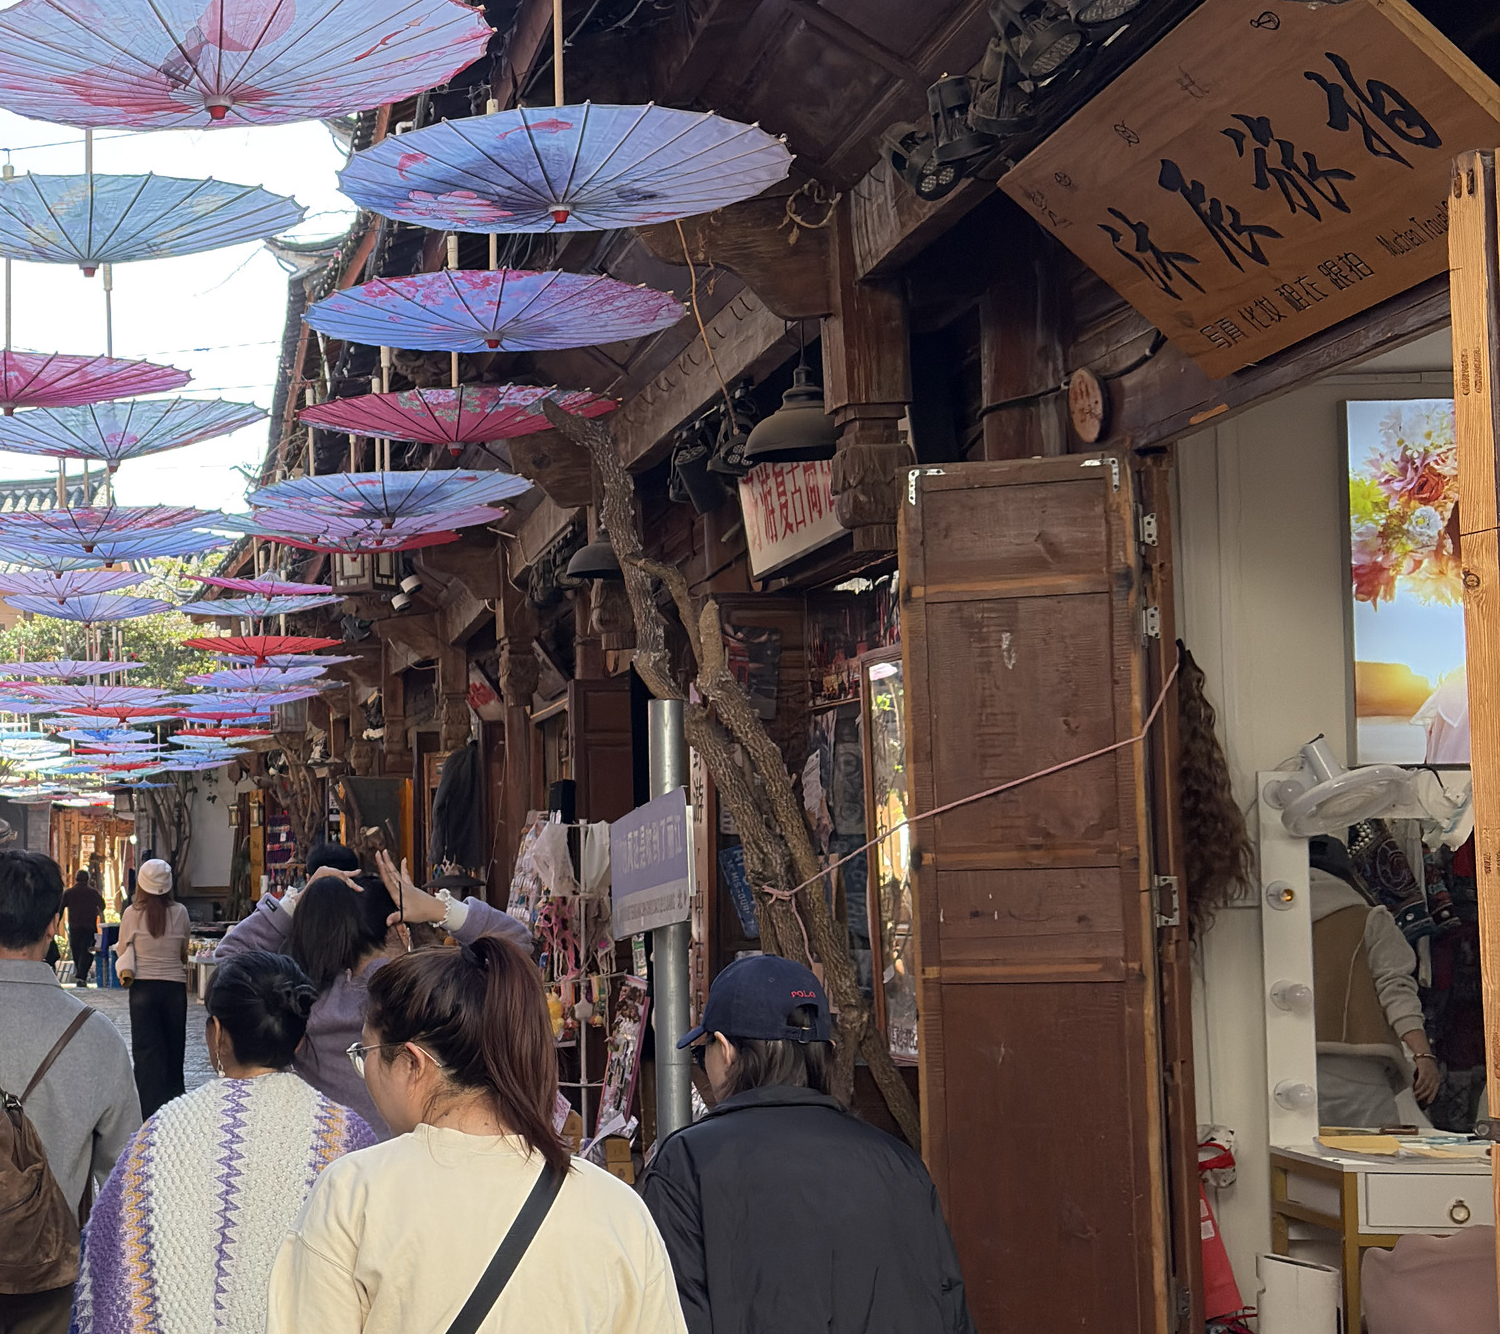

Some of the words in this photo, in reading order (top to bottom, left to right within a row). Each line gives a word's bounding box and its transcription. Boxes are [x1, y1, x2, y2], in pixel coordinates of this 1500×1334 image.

[1237, 295, 1288, 333] 化妆
[1316, 251, 1376, 291] 跟拍
[790, 990, 817, 999] POLO
